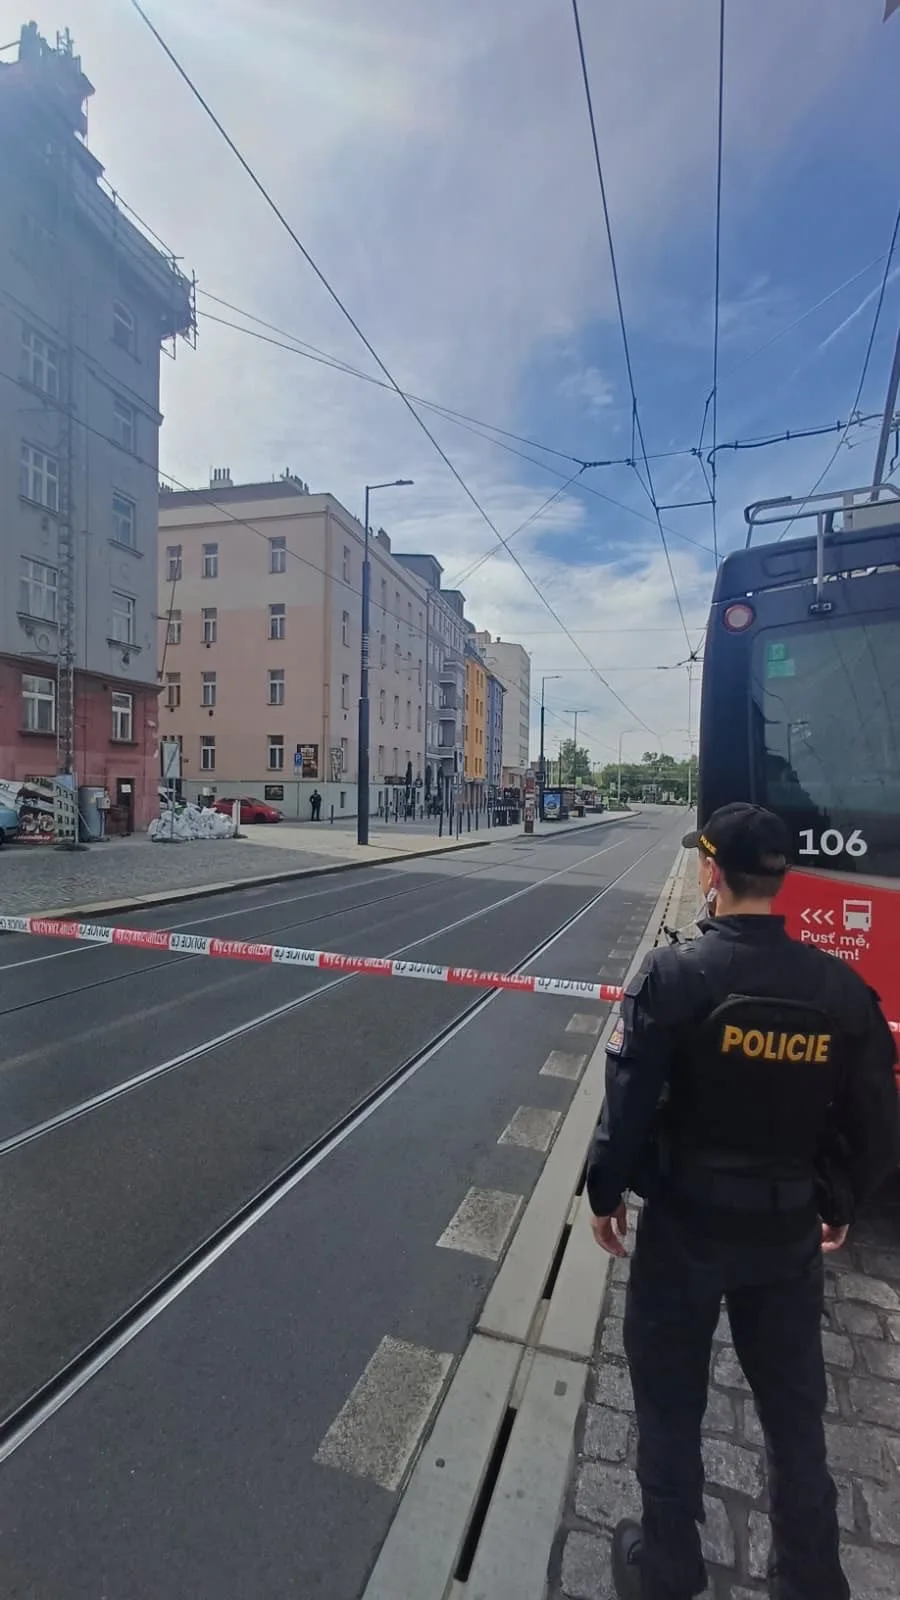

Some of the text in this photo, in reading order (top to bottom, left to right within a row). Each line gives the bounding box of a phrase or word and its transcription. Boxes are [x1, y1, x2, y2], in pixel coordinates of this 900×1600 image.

[799, 829, 868, 857] 106
[181, 937, 206, 950] POLICIE
[800, 930, 870, 949] Pusť mě,
[721, 1024, 832, 1062] POLICIE
